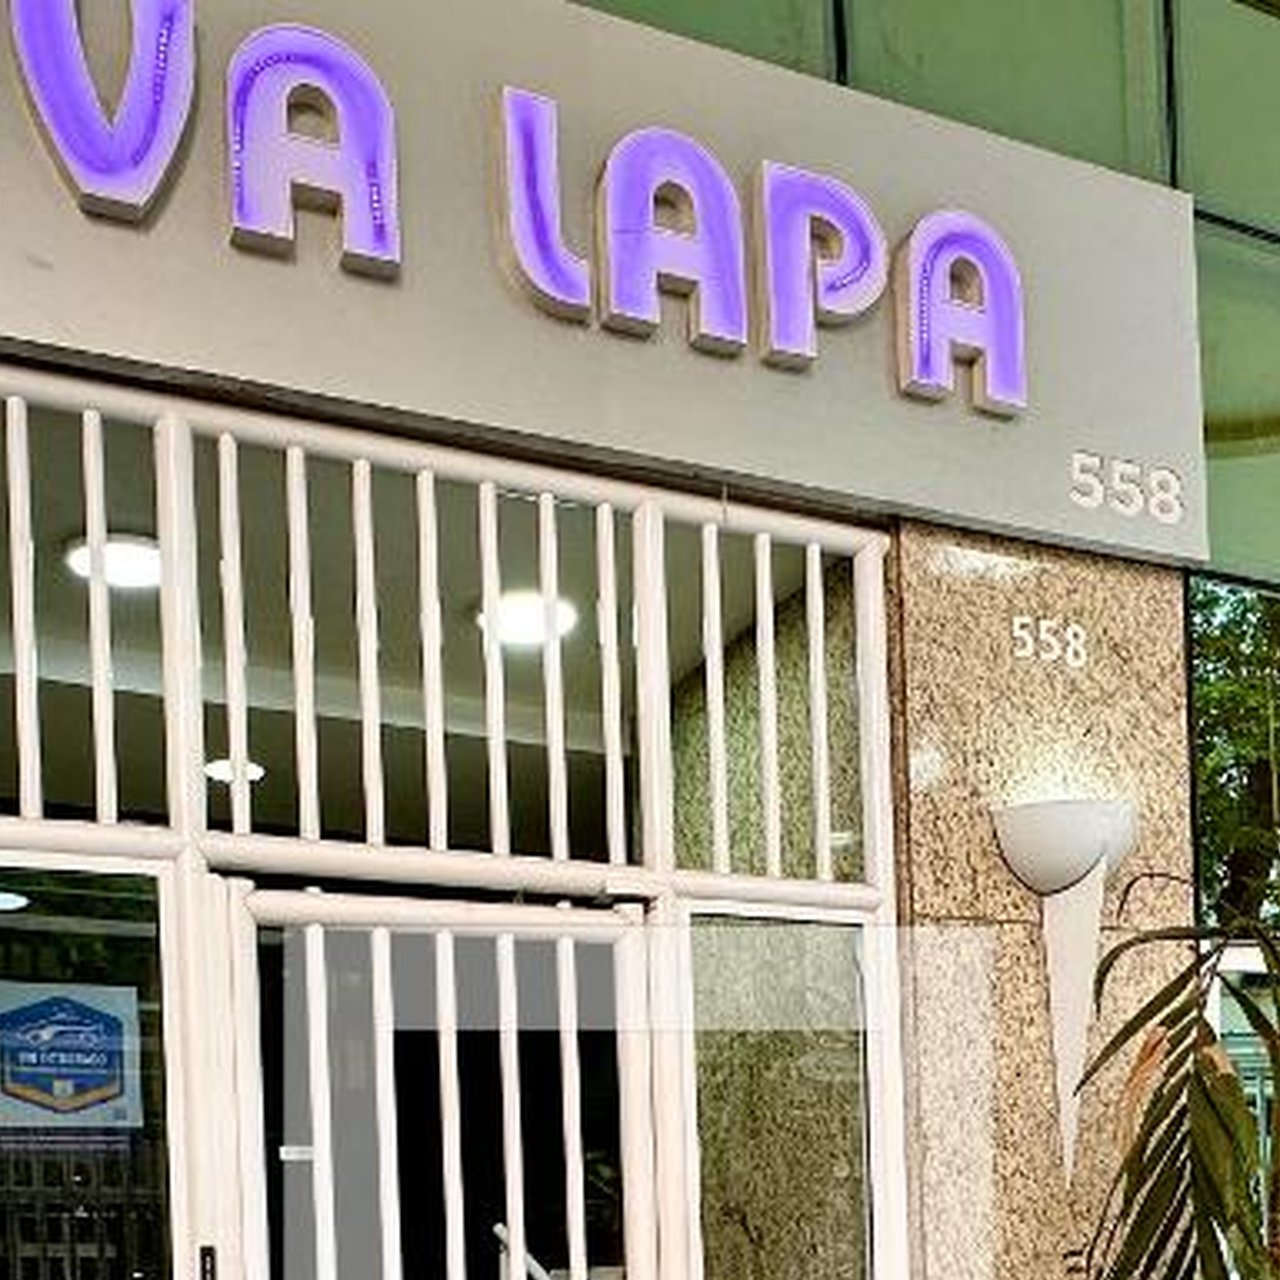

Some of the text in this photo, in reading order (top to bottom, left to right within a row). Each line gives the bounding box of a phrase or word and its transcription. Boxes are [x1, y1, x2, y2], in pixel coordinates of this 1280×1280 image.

[498, 84, 1028, 418] LAPA
[1070, 450, 1185, 525] 558
[1012, 615, 1088, 668] 558
